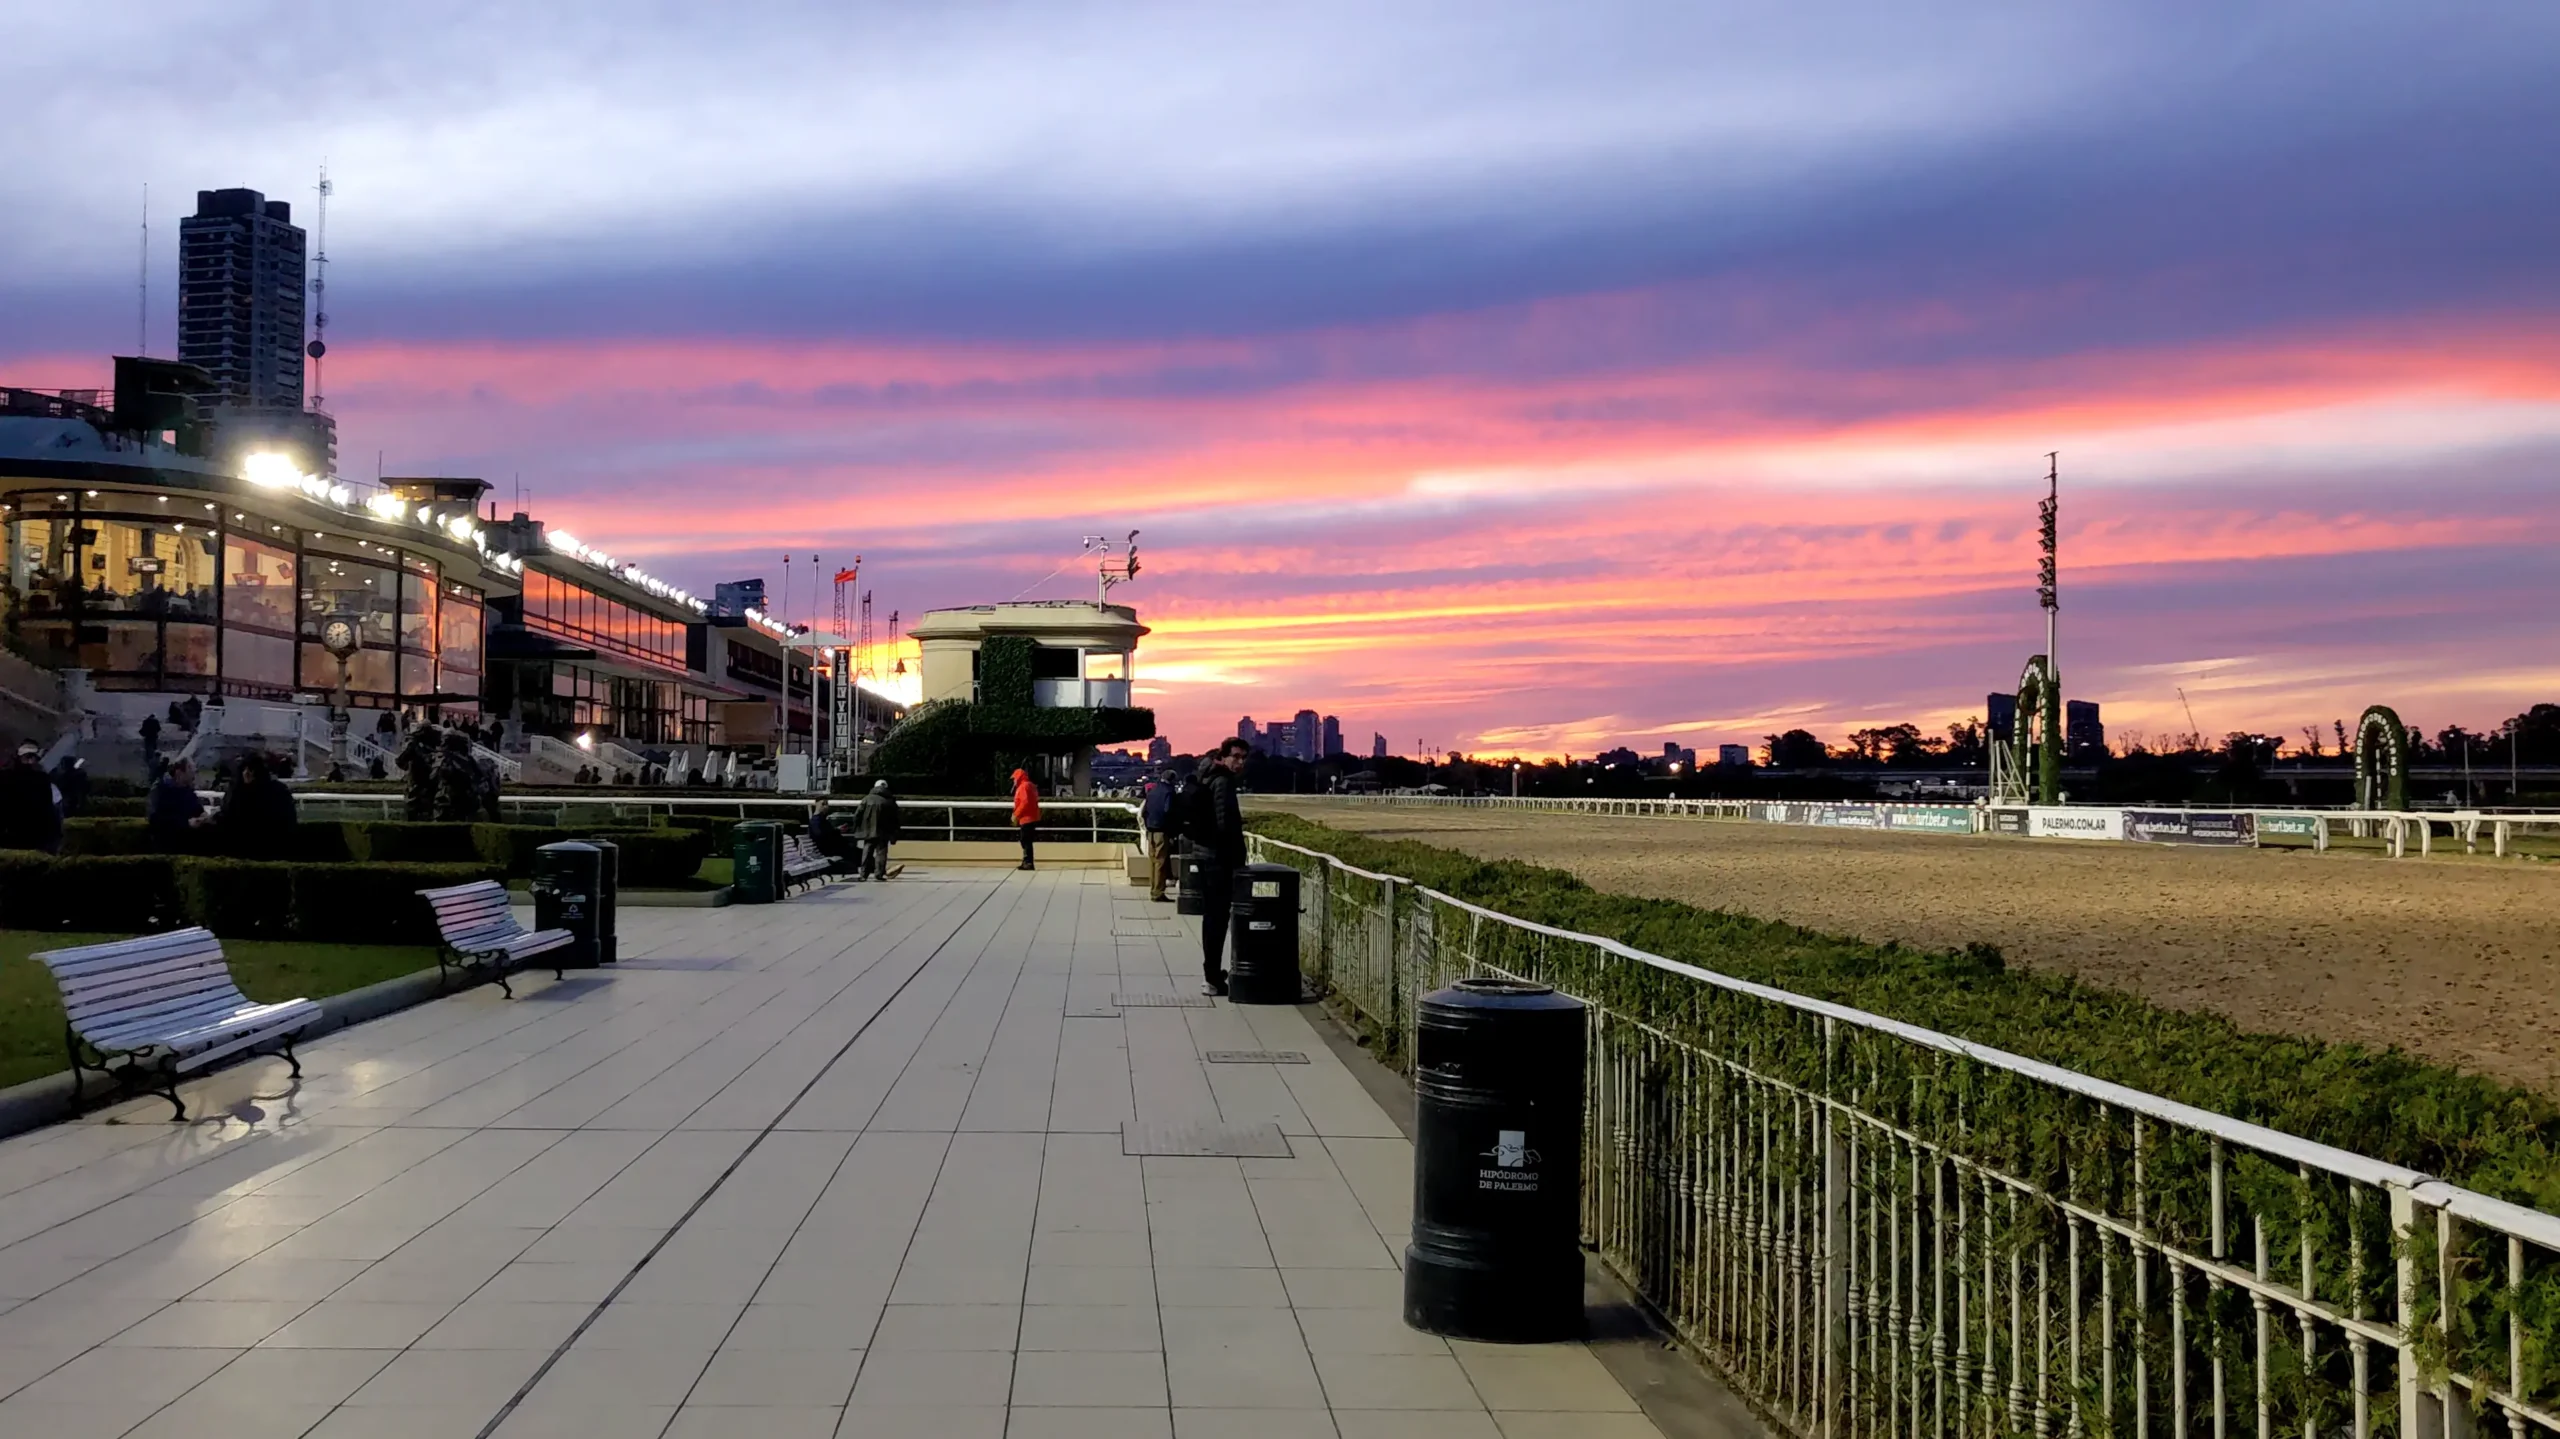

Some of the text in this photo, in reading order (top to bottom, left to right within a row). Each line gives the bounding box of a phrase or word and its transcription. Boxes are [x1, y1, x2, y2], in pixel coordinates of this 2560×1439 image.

[2042, 817, 2106, 831] PALERMO.COM.AR
[1479, 1169, 1539, 1181] HIPÓDROMO
[1479, 1180, 1539, 1192] DE PALERMO
